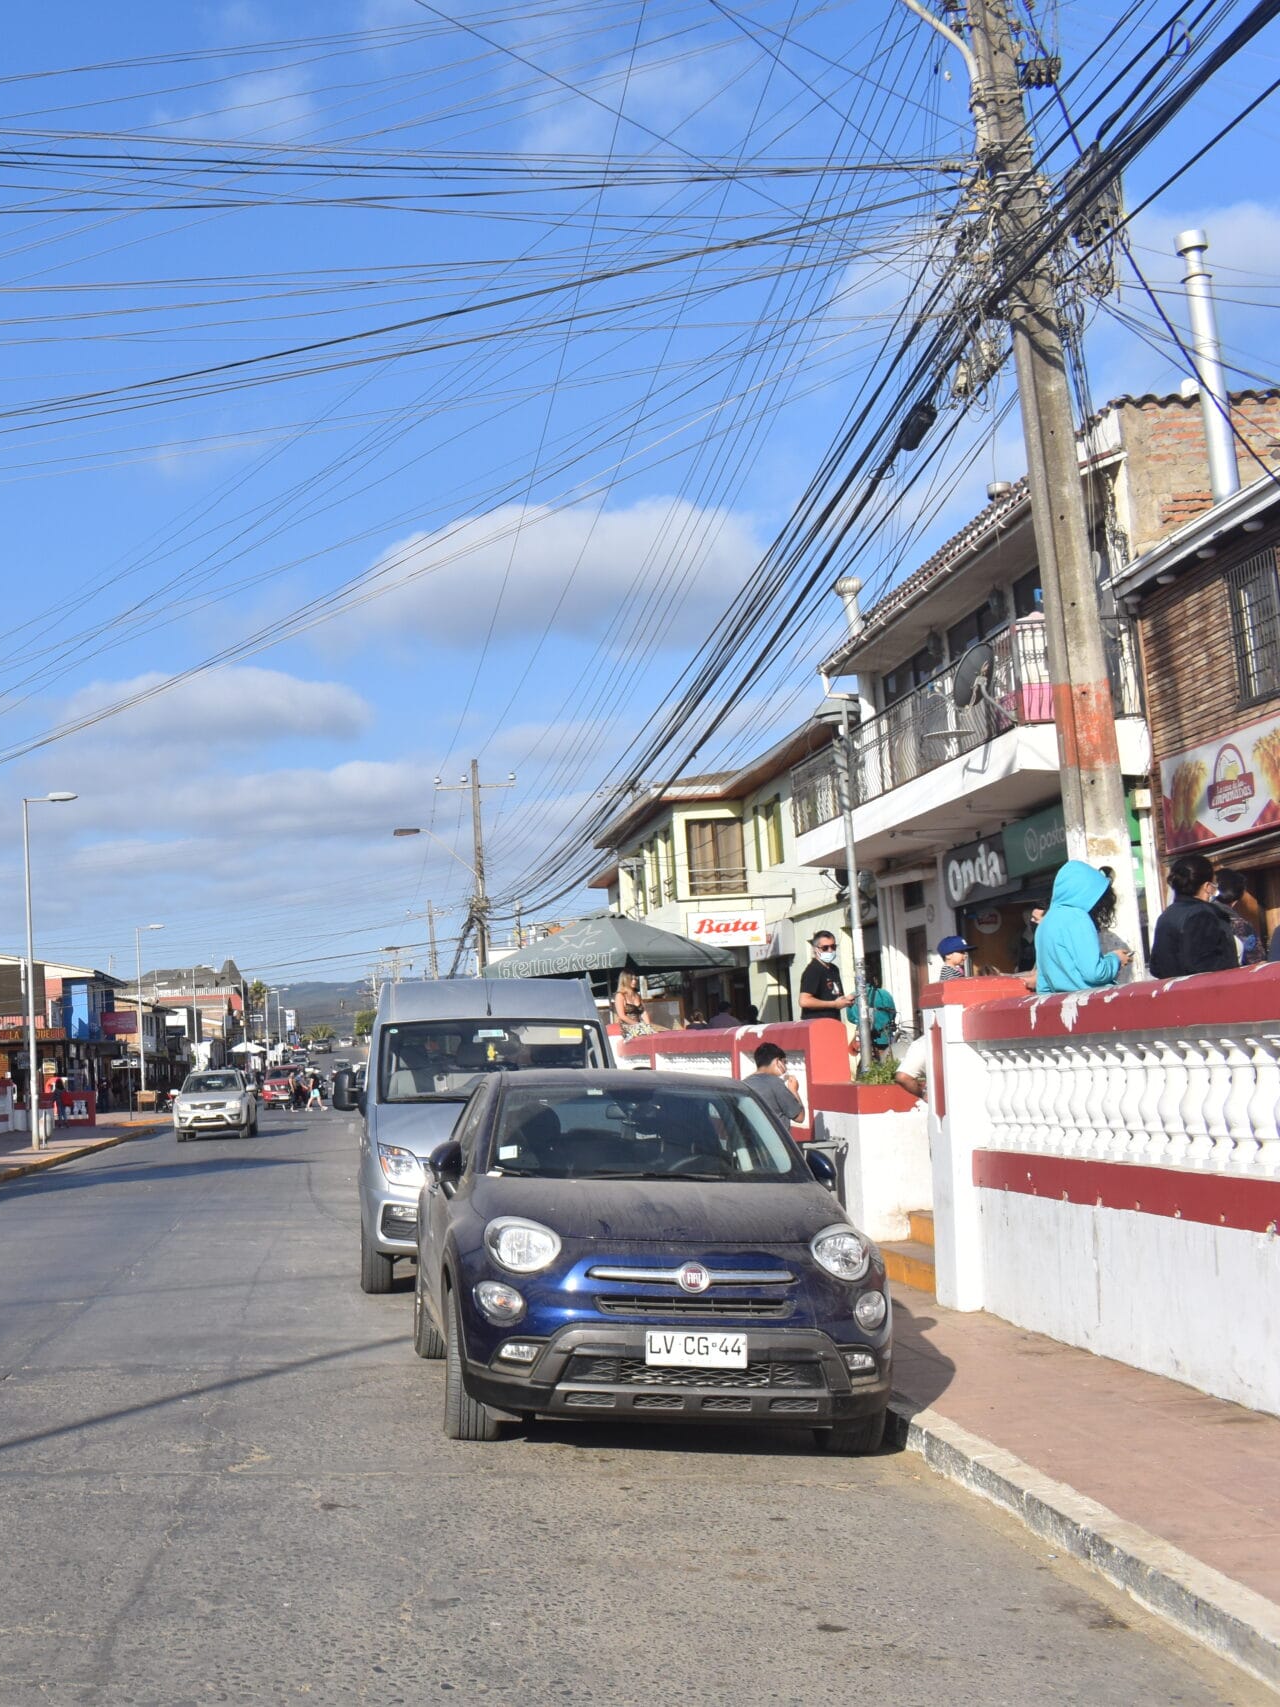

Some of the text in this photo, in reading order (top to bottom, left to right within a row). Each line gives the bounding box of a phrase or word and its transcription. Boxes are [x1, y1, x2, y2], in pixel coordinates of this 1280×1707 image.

[694, 918, 760, 935] Bata
[498, 952, 612, 979] Heineken
[687, 1272, 703, 1284] FIAT
